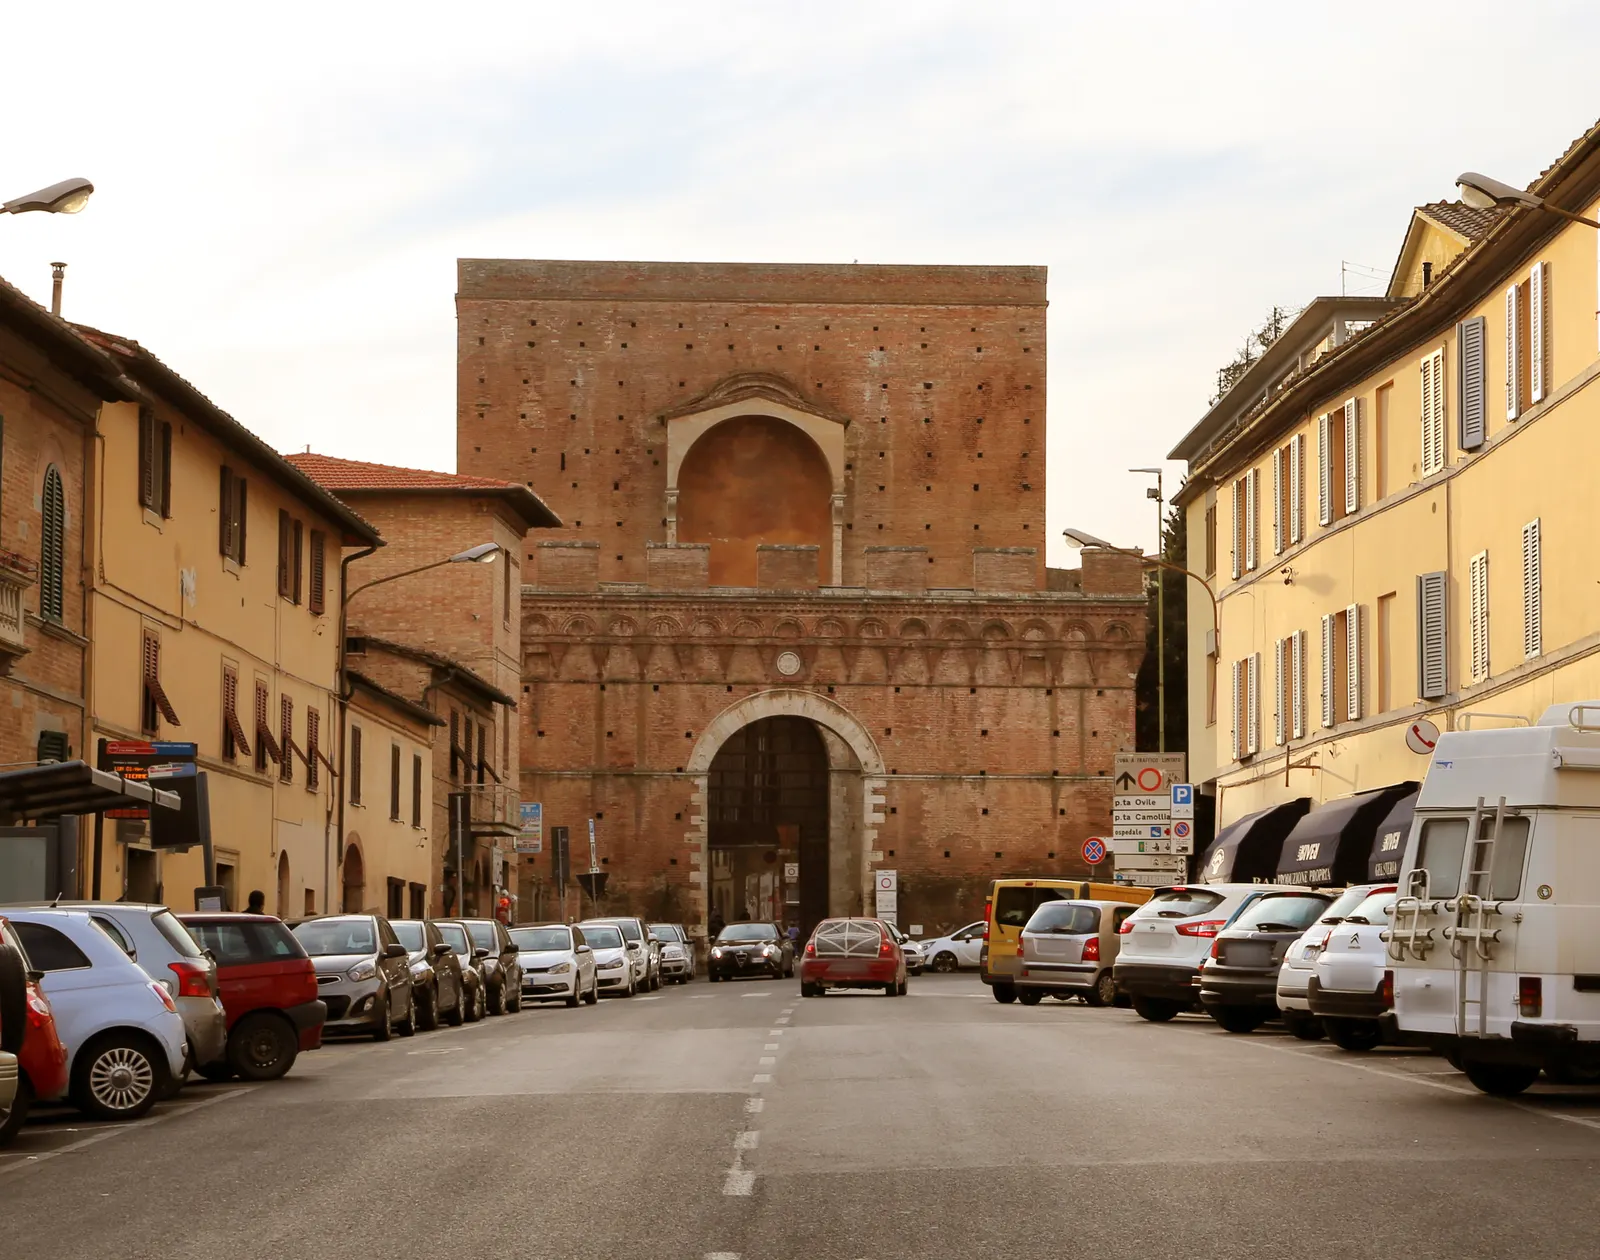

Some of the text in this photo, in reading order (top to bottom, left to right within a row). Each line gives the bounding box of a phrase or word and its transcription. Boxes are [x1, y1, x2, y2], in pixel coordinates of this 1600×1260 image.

[1176, 788, 1188, 802] P
[1135, 798, 1156, 806] Ovile
[1135, 813, 1171, 821] Camollia
[1115, 828, 1142, 836] ospedale
[1277, 867, 1331, 885] PRODUZIONE PROPRIA
